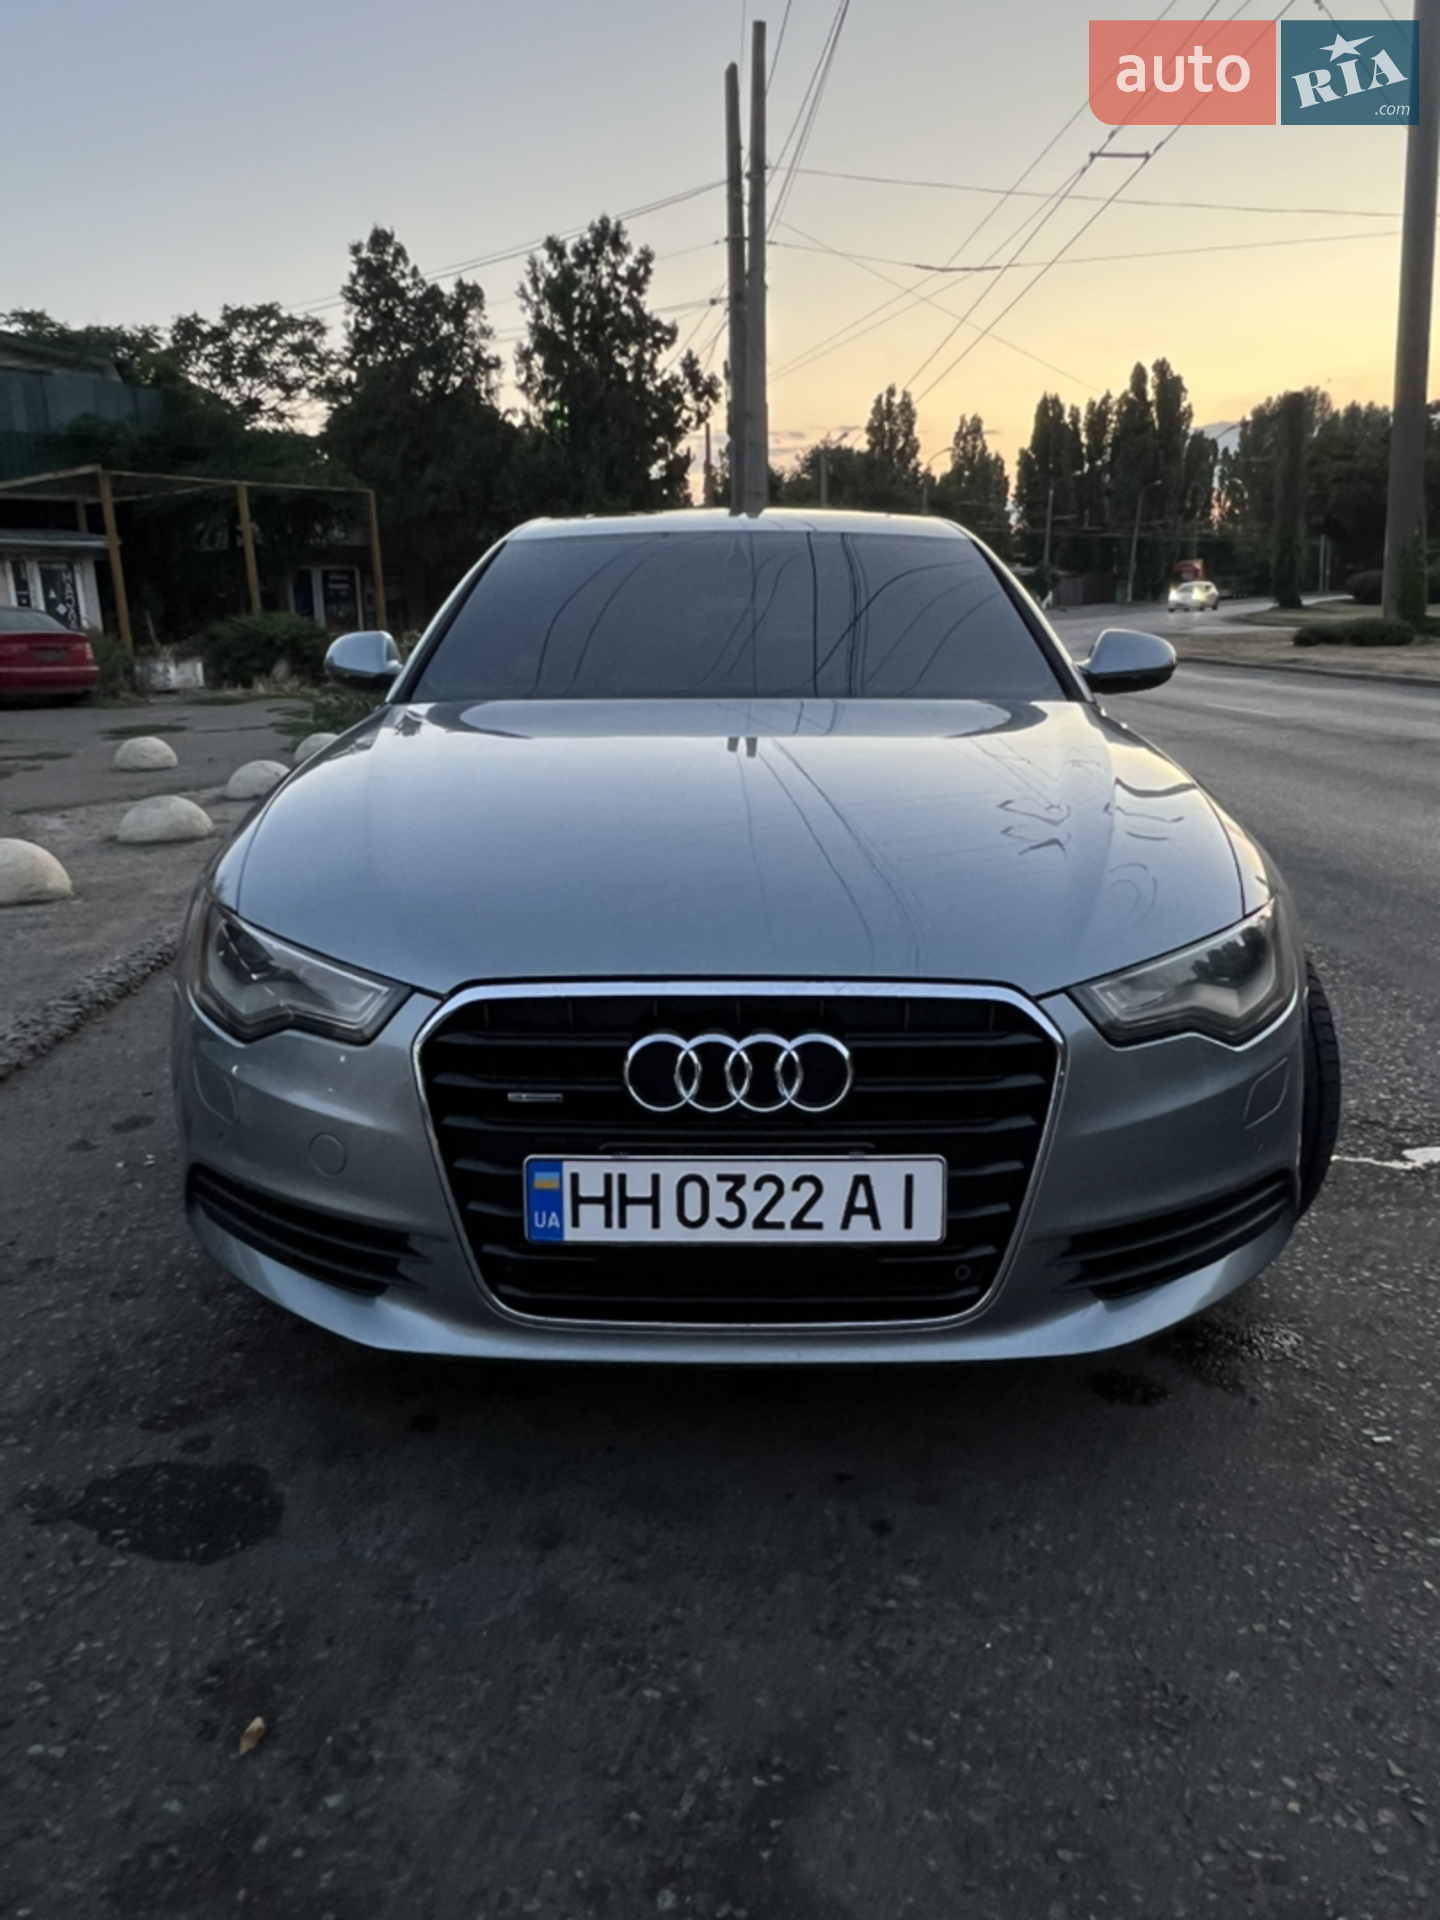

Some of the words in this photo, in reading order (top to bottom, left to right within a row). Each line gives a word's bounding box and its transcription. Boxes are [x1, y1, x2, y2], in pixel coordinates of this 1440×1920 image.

[533, 1210, 561, 1229] UA
[570, 1172, 661, 1229] HH
[676, 1173, 824, 1230] 0322
